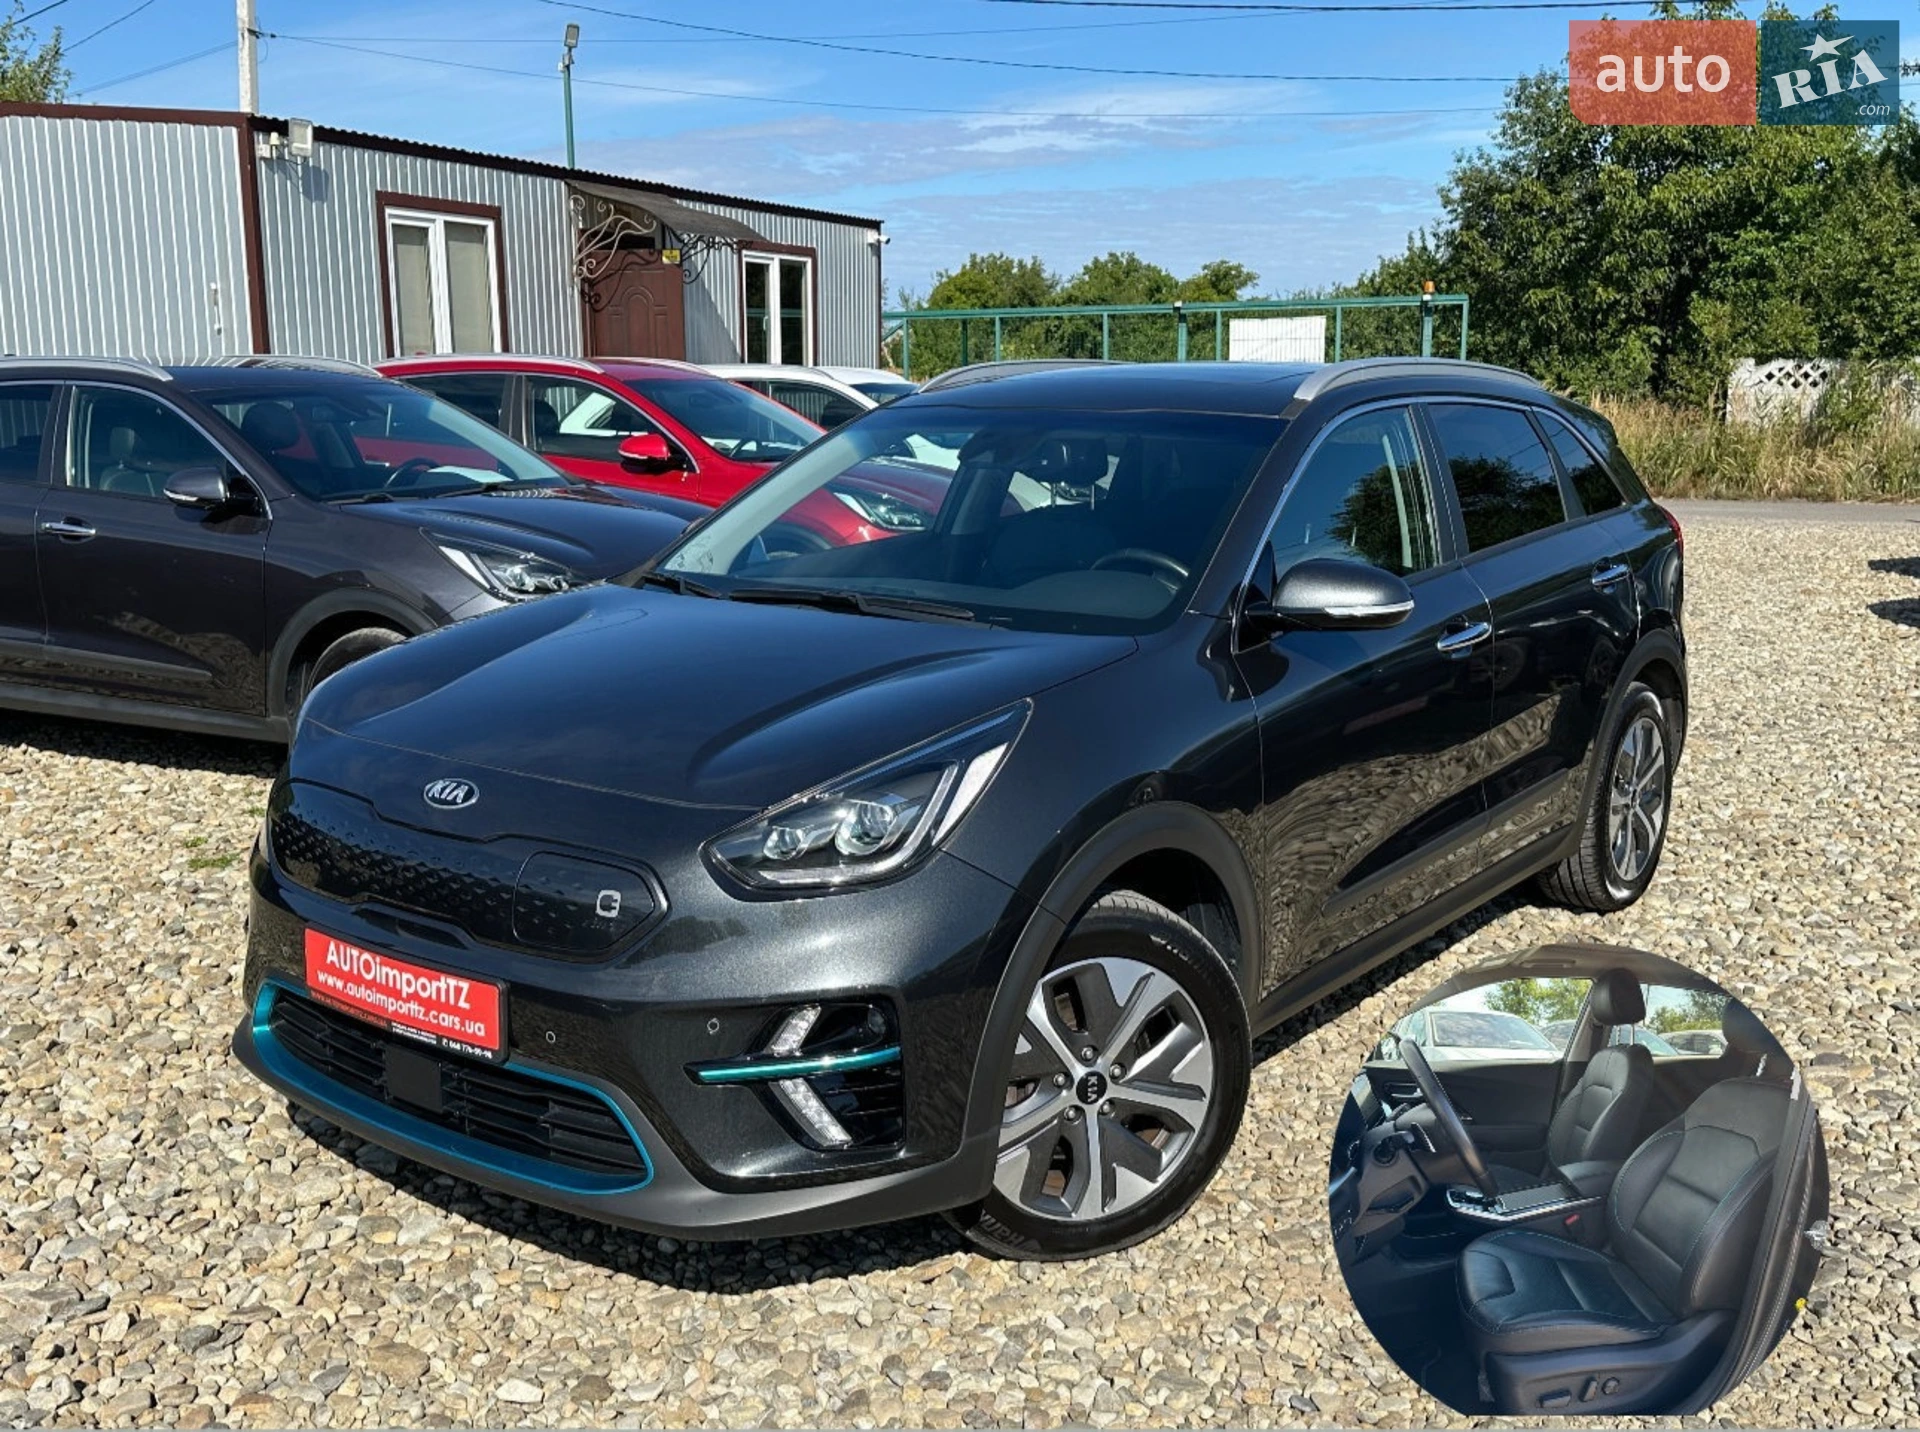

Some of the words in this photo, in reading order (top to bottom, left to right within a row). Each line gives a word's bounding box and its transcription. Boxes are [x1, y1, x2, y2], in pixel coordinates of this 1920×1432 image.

[427, 780, 469, 804] KIA
[326, 940, 471, 1010] AUTOimportTZ
[317, 970, 485, 1037] www.autoimporttz.cars.ua
[1087, 1075, 1098, 1103] KIA
